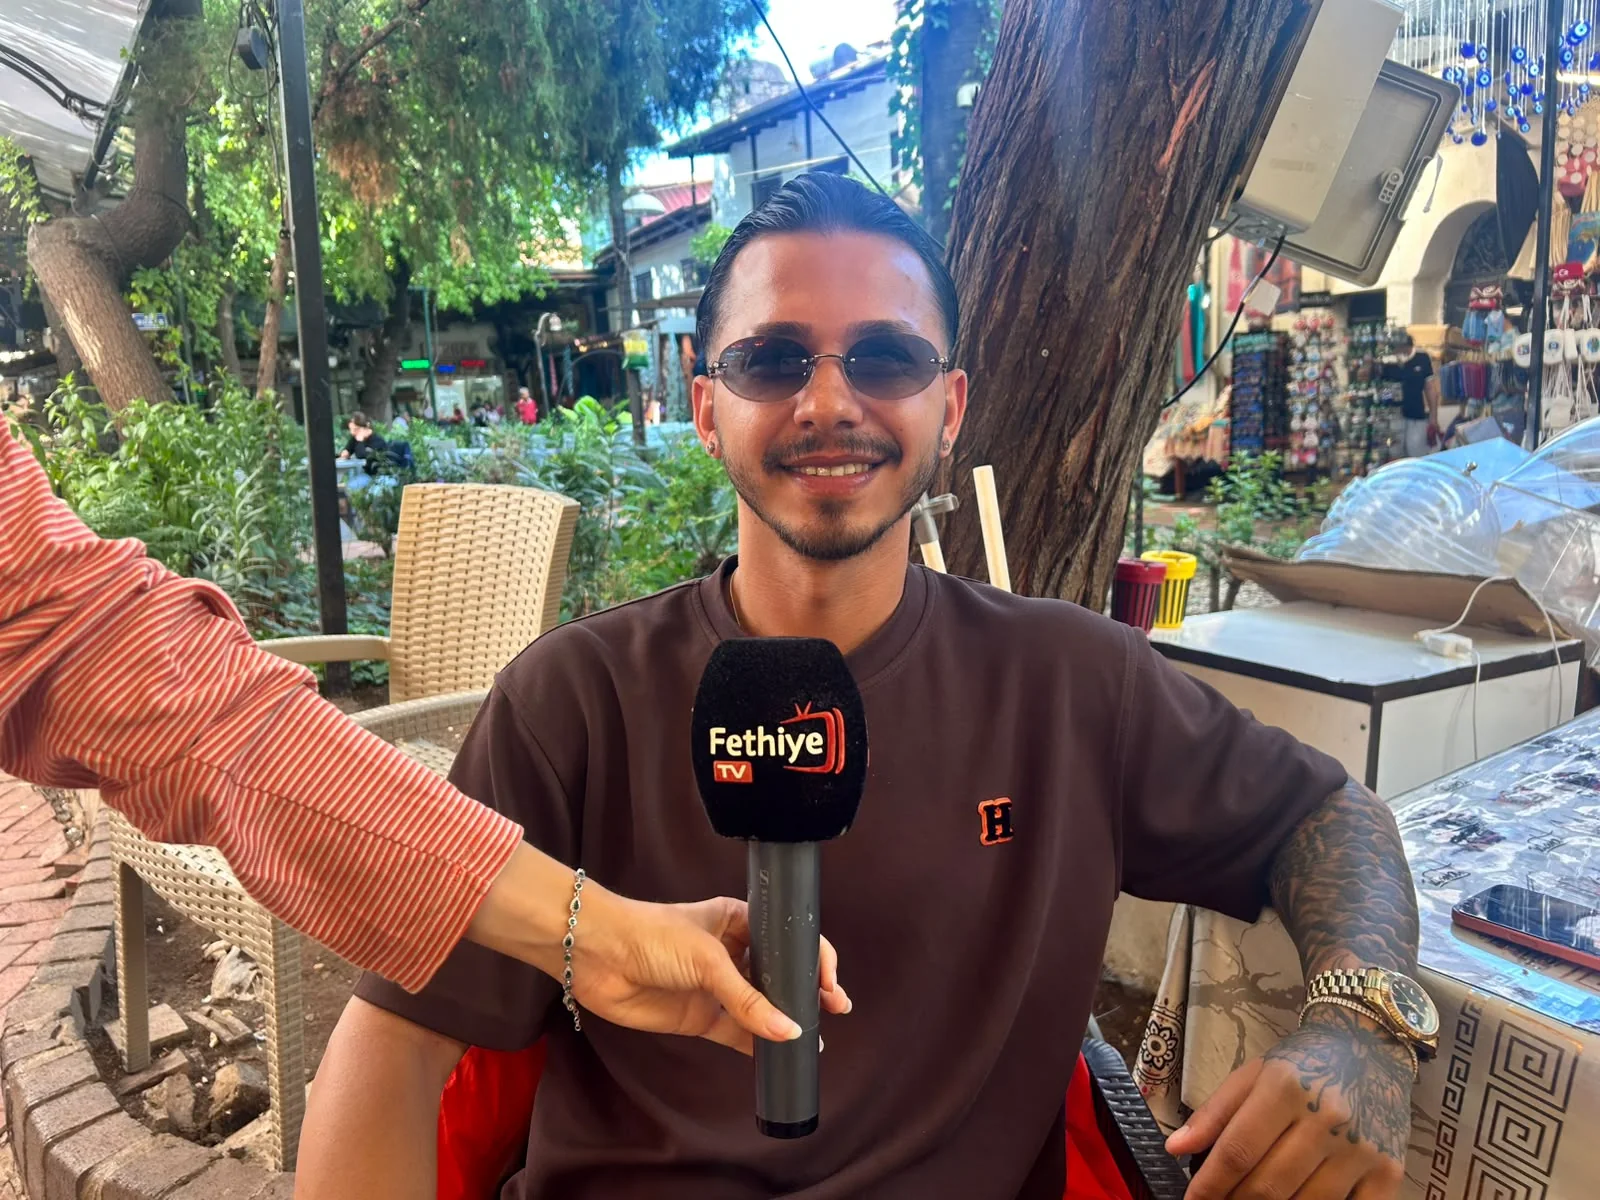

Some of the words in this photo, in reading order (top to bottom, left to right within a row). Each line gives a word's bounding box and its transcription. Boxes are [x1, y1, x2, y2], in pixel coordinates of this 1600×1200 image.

[709, 725, 824, 764] Fethiye
[716, 763, 747, 779] TV
[979, 798, 1013, 845] H
